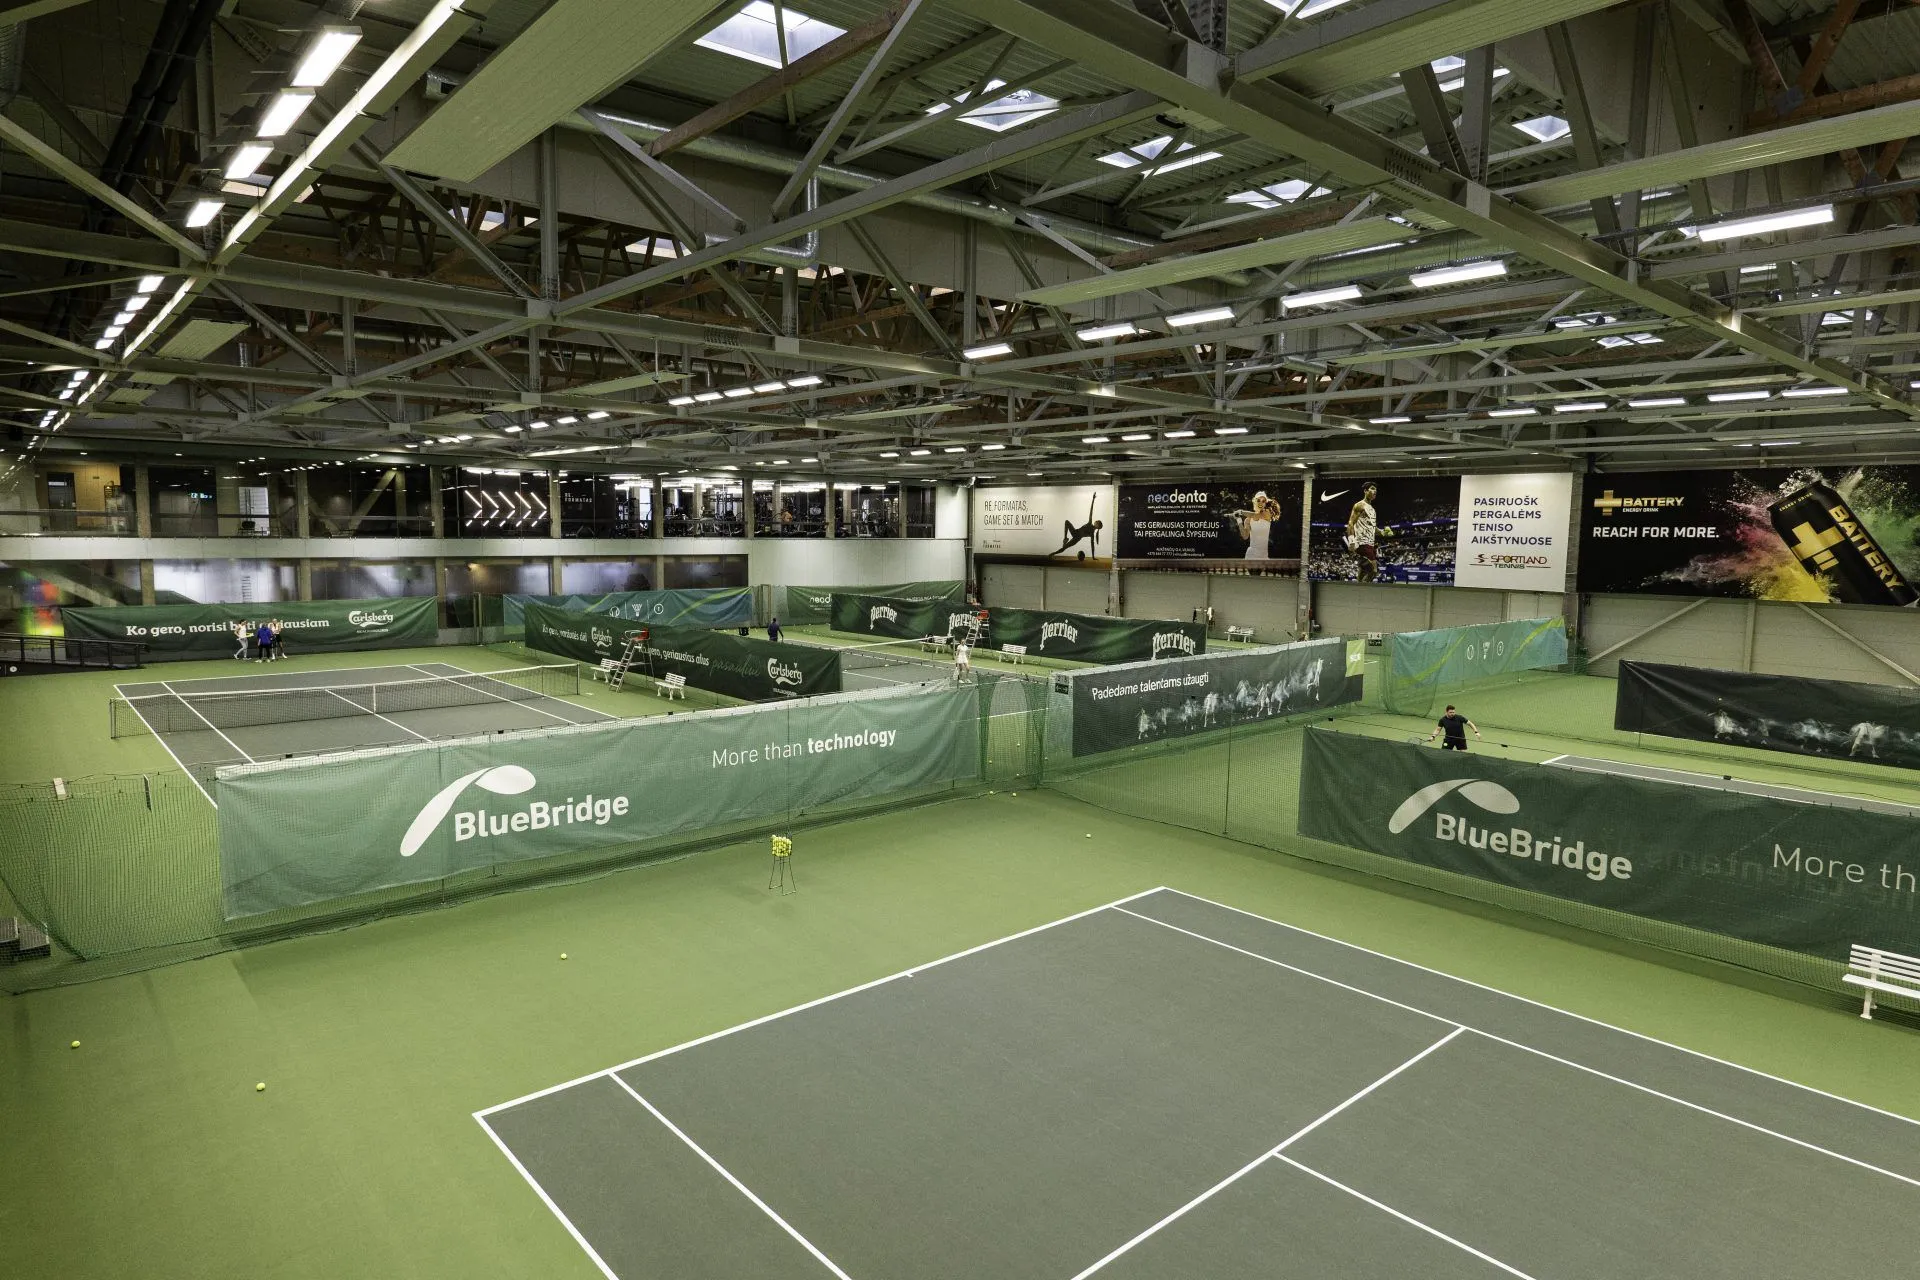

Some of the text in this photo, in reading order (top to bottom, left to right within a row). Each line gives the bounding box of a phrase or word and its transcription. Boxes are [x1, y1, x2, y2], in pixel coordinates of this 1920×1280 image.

[1148, 489, 1207, 503] neodenta
[1474, 496, 1538, 506] PASIRUOŠK
[1623, 497, 1685, 507] BATTERY
[984, 515, 1001, 525] GAME
[1003, 515, 1013, 525] SET
[1022, 515, 1044, 525] MATCH
[1473, 509, 1542, 519] PERGALĖMS
[1186, 521, 1220, 529] TROFĖJUS
[1592, 527, 1720, 538] REACH FOR MORE.
[1471, 534, 1553, 546] AIKŠTYNUOSE
[1828, 504, 1905, 589] BATTERY
[1490, 555, 1548, 565] SPORTLAND
[348, 609, 394, 626] Carlsberg
[126, 625, 148, 636] Ko
[150, 625, 187, 637] gero,
[189, 621, 228, 634] norisi
[230, 620, 257, 633] bti
[663, 649, 695, 663] geriausias
[696, 653, 710, 666] alus
[767, 657, 802, 685] Carlsberg
[1092, 672, 1209, 701] Padedame talentams užaugti
[712, 729, 897, 769] More than technology
[454, 794, 630, 842] BlueBridge
[1436, 812, 1633, 881] BlueBridge
[1773, 843, 1865, 883] More
